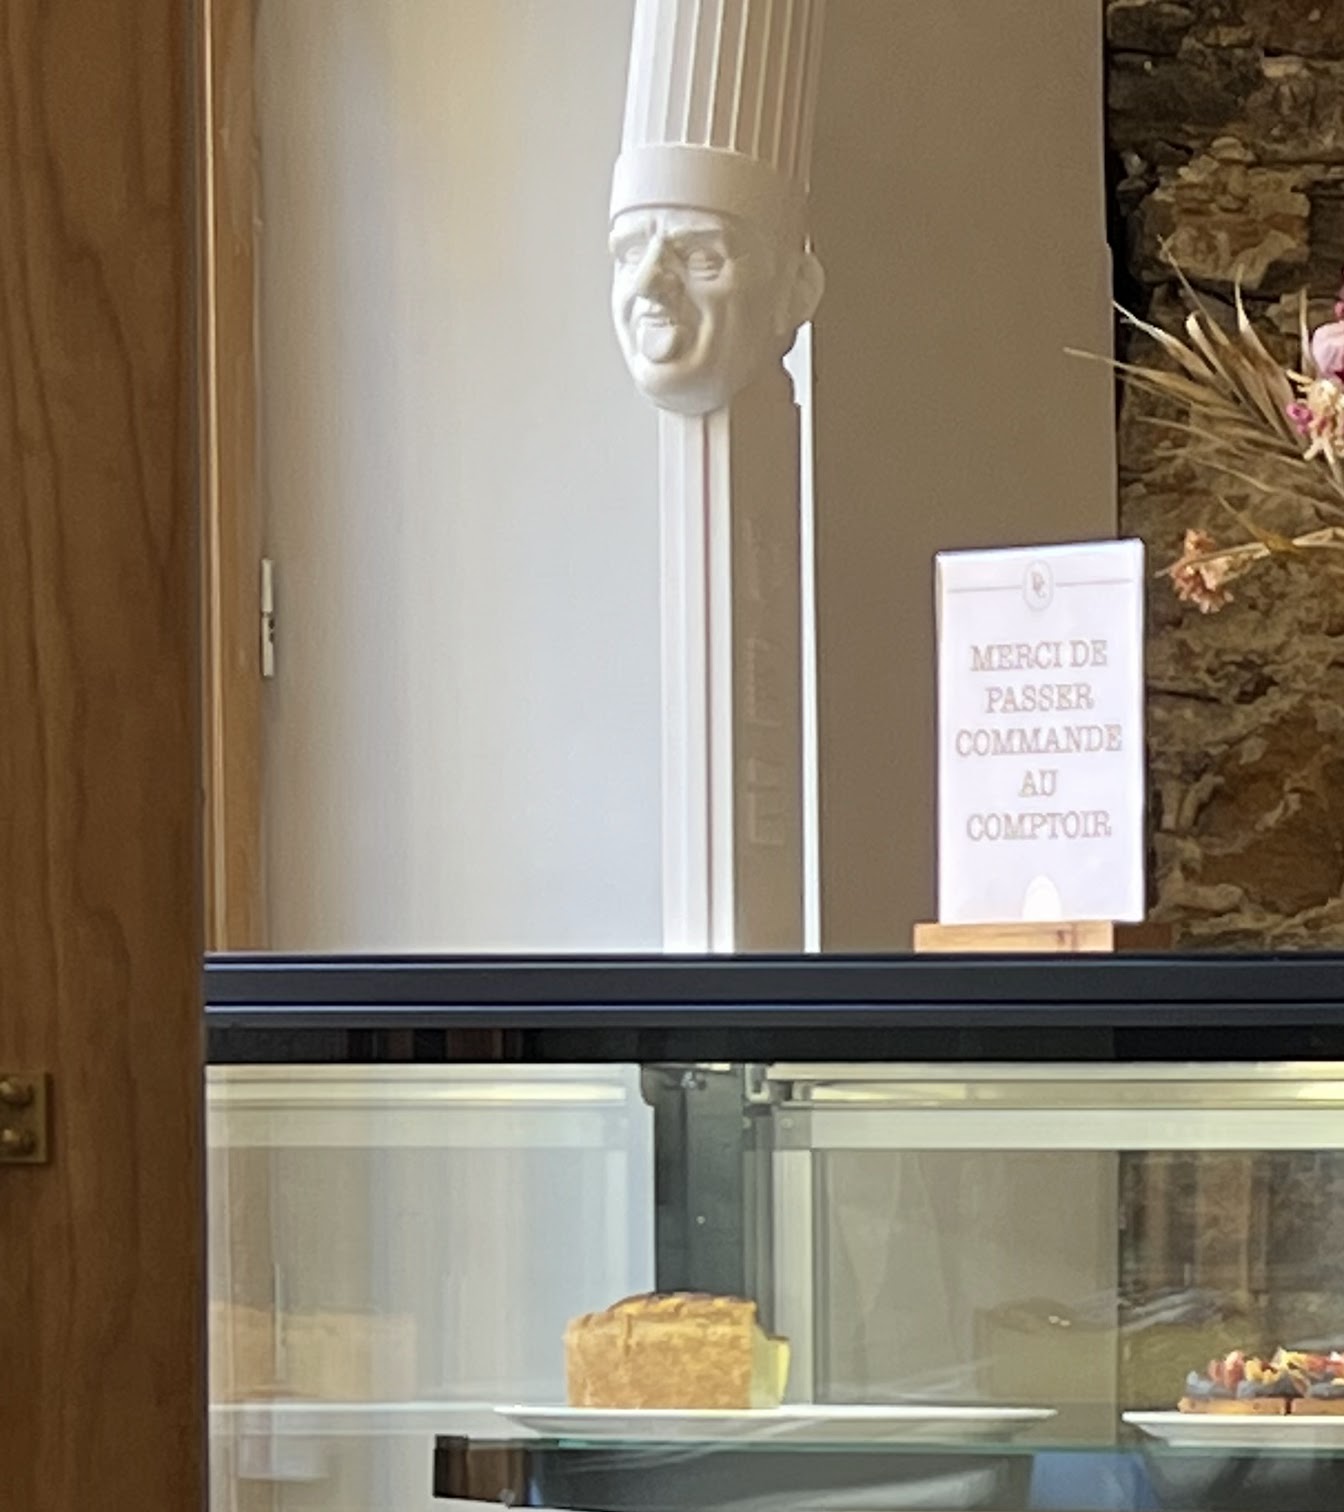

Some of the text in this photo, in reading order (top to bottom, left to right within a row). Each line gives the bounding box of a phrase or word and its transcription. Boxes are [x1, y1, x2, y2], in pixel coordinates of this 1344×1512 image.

[970, 640, 1108, 671] MERCI DE
[984, 683, 1094, 713] PASSER
[956, 724, 1123, 757] COMMANDE
[1019, 769, 1058, 797] AU
[967, 811, 1112, 841] COMPTOIR
